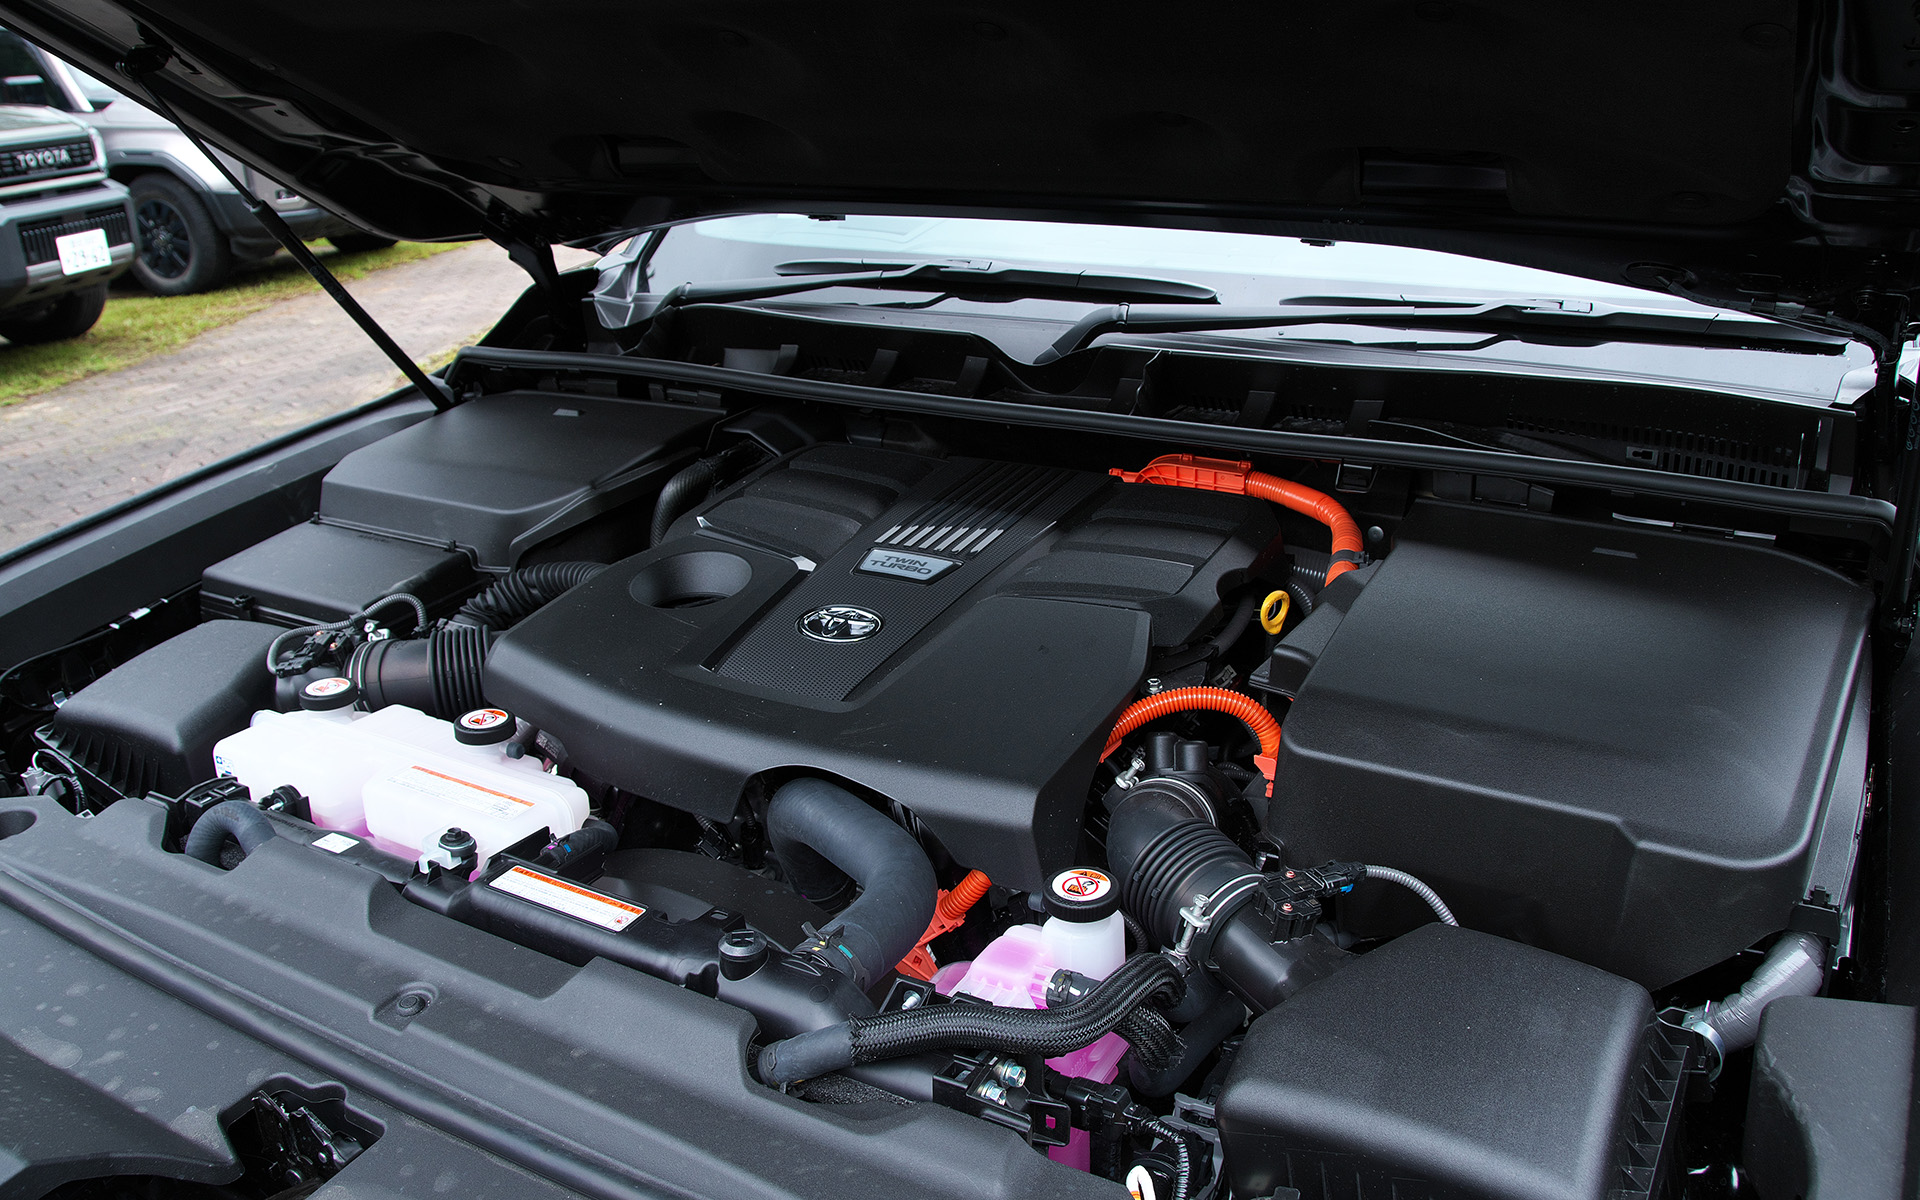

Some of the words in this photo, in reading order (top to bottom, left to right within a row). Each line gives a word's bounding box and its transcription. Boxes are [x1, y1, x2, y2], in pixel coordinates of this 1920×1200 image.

[17, 149, 71, 169] TOYOTA
[870, 559, 932, 575] TURBO
[884, 555, 928, 567] TWIN
